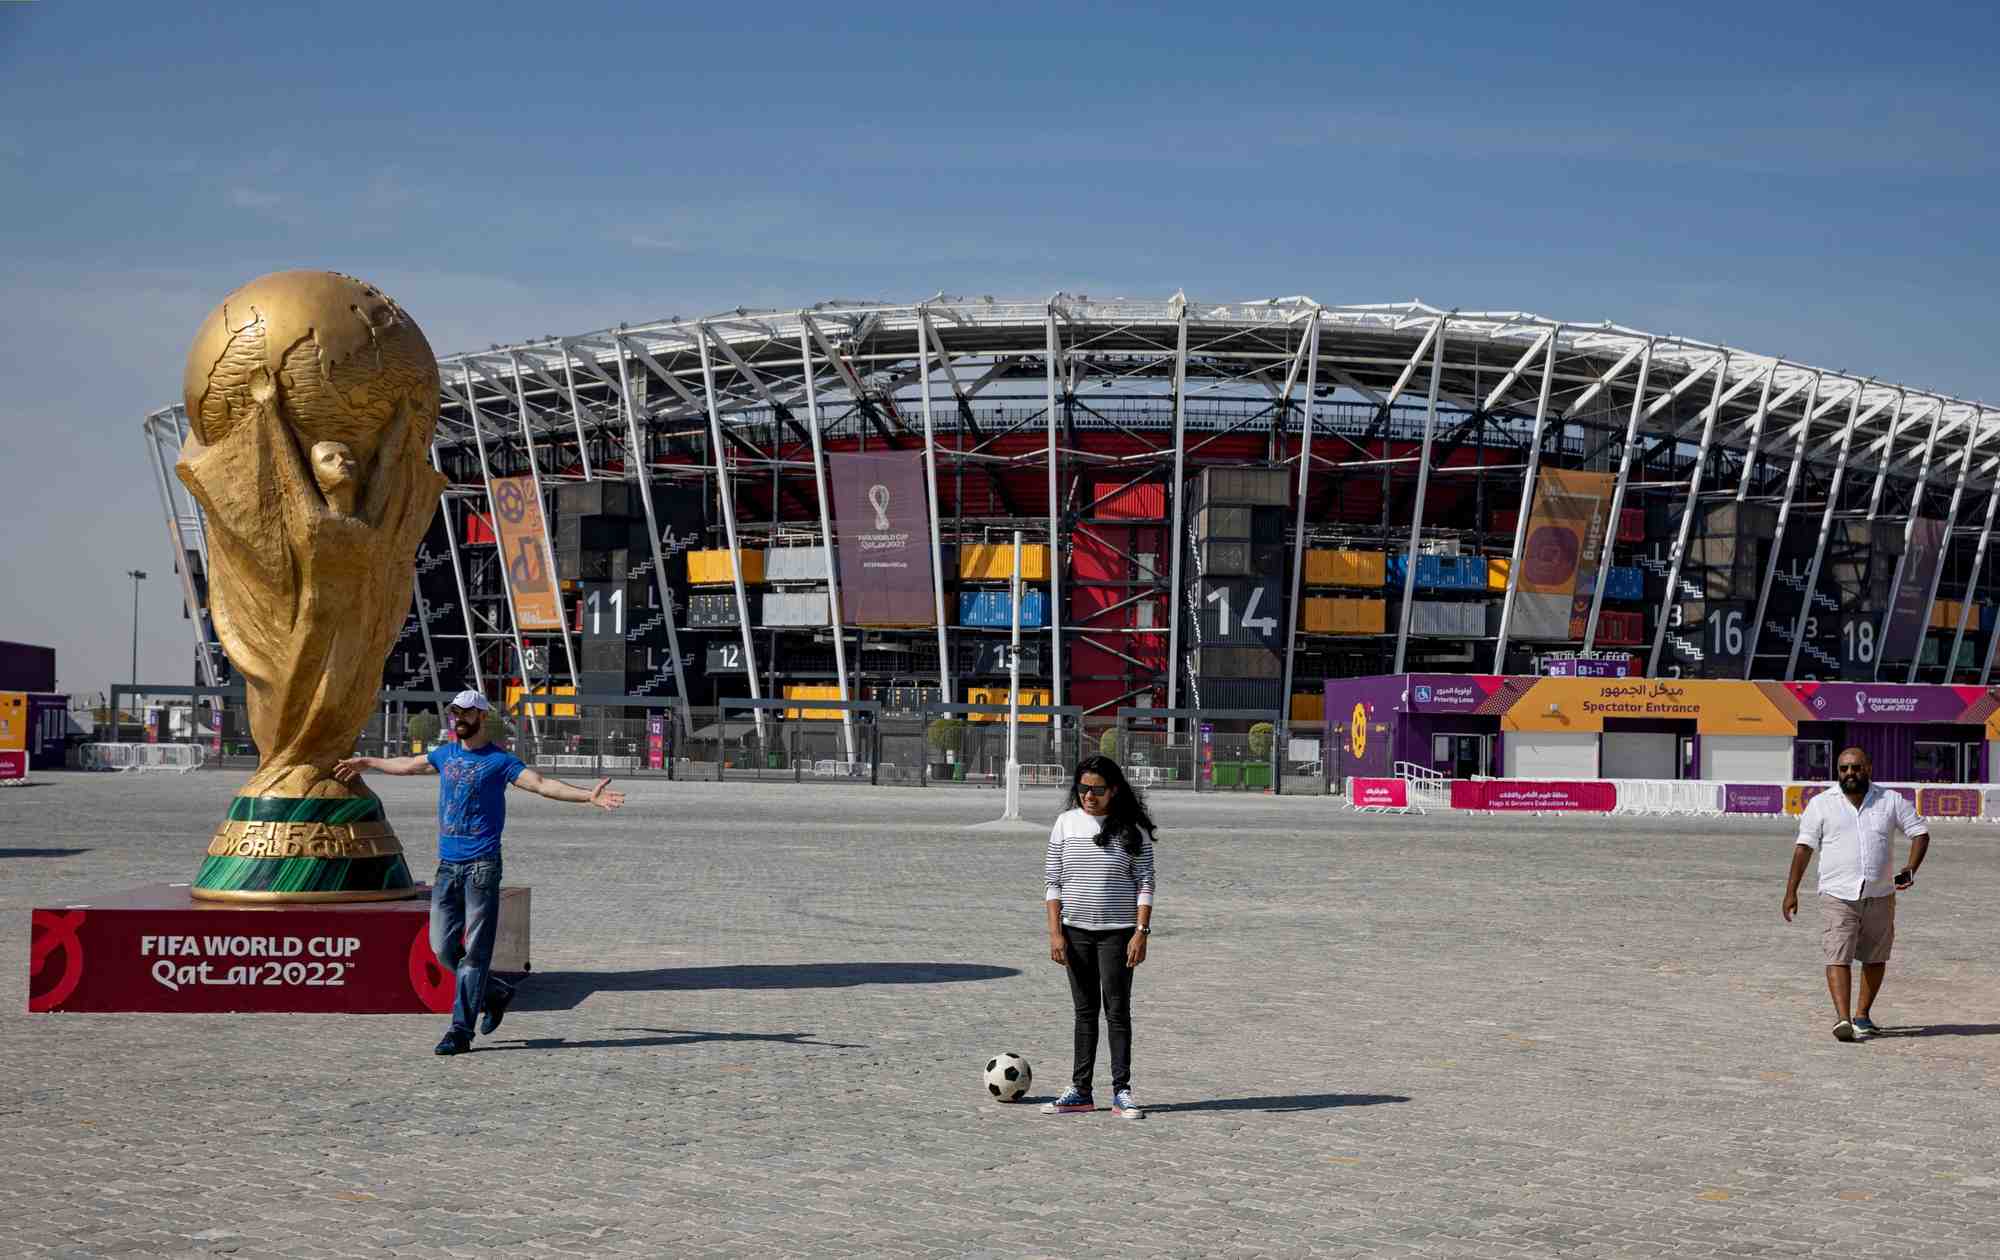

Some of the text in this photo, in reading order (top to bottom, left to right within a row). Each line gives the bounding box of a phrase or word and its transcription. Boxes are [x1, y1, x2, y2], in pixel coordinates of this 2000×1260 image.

[587, 589, 622, 634] 11
[1207, 587, 1277, 635] 14
[1708, 609, 1742, 655] 16
[1843, 620, 1874, 662] 18
[720, 645, 738, 667] 12
[1600, 683, 1684, 698] مدخل الجمهور
[1583, 701, 1700, 713] Spectator Entrance
[242, 821, 334, 841] FIFA
[226, 839, 300, 857] WORLD
[141, 936, 361, 957] FIFA WORLD CUP
